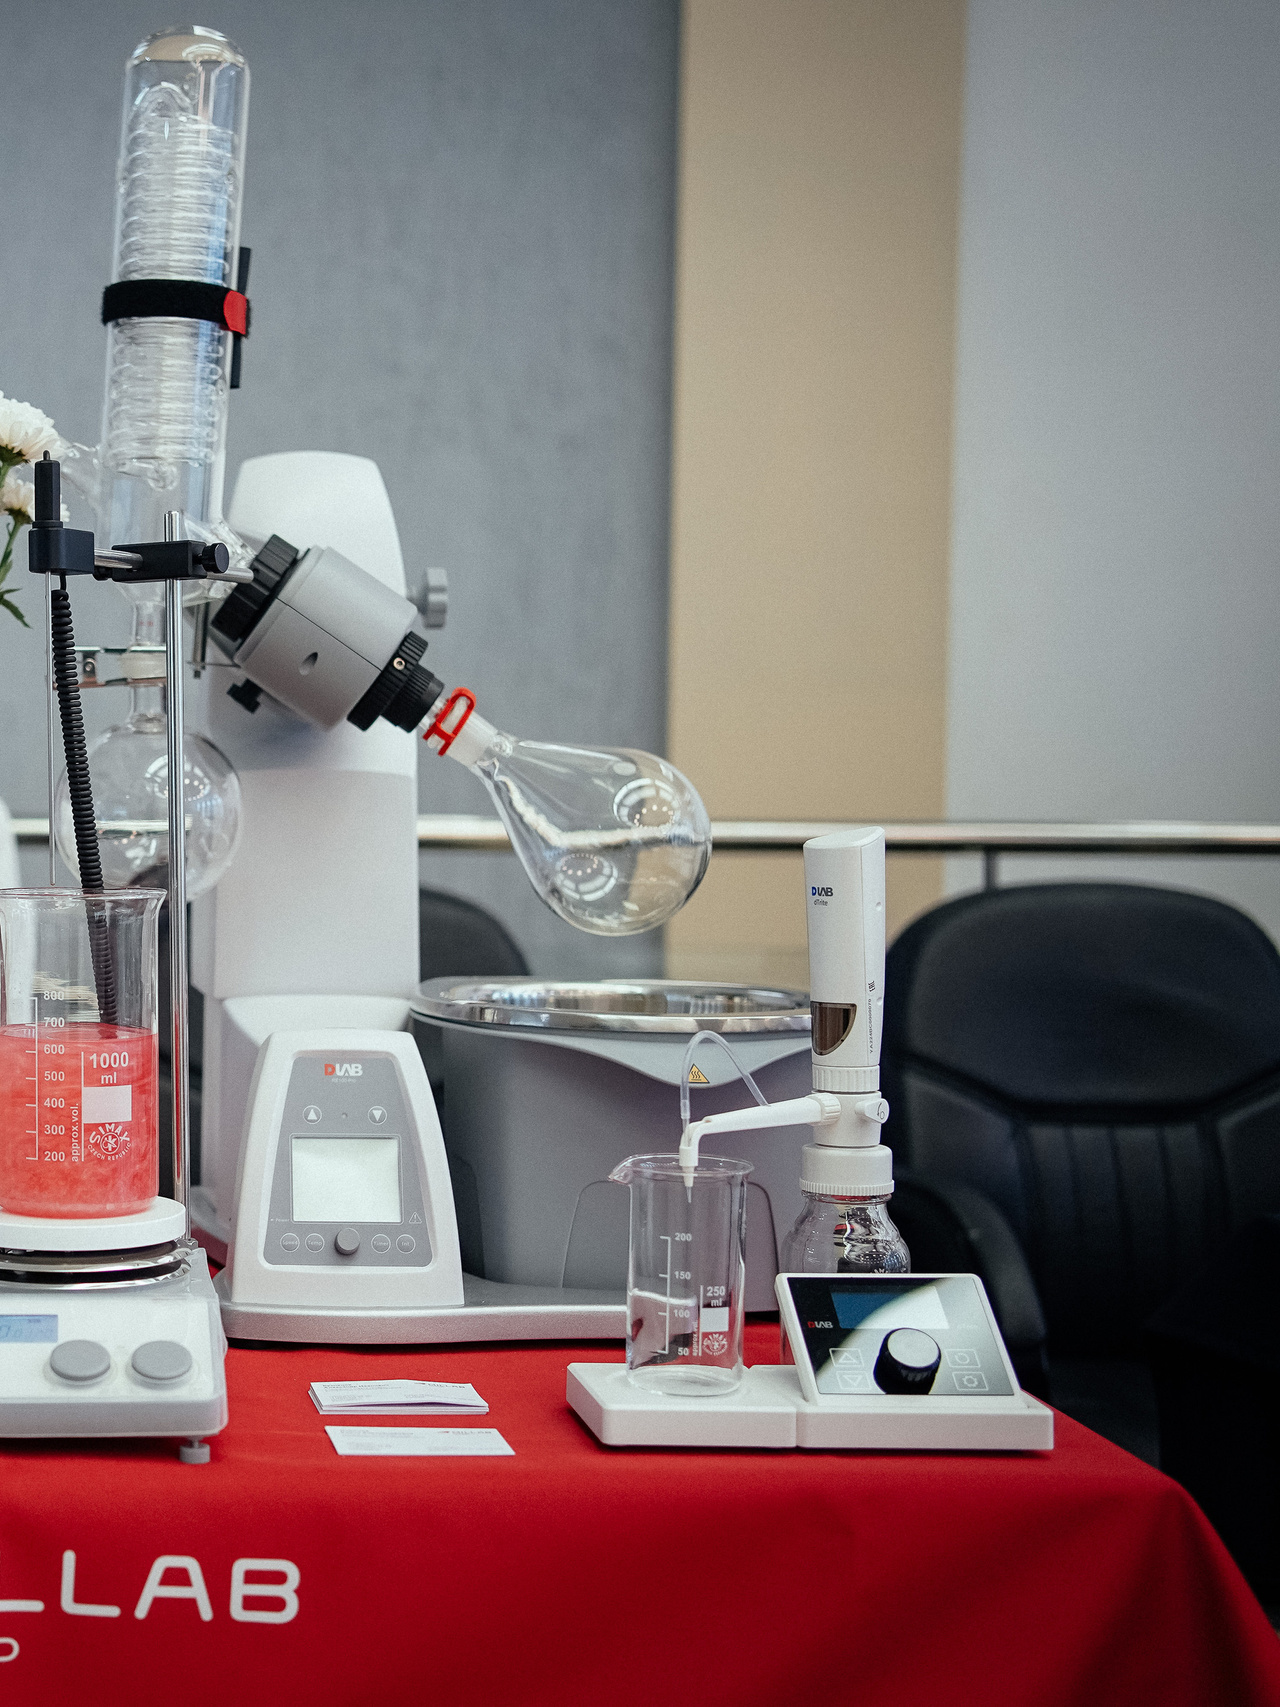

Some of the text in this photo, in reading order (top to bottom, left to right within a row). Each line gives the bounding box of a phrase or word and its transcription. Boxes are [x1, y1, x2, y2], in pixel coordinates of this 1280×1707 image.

[811, 886, 834, 897] DLAB
[43, 991, 65, 1000] 800
[43, 1017, 65, 1027] 700
[43, 1044, 65, 1054] 600
[89, 1052, 129, 1068] 1000
[324, 1063, 363, 1077] DLAB
[43, 1071, 65, 1081] 500
[101, 1072, 117, 1084] ml
[43, 1098, 65, 1108] 400
[43, 1125, 65, 1135] 300
[71, 1103, 79, 1162] approx.vol.
[89, 1123, 130, 1144] SIMAX
[43, 1151, 65, 1162] 200
[87, 1142, 132, 1161] CZECH REPUBLIC
[674, 1232, 692, 1242] 200
[674, 1271, 691, 1280] 150
[706, 1286, 726, 1296] 250
[711, 1298, 722, 1307] ml
[673, 1309, 690, 1318] 100
[807, 1321, 834, 1329] DLAB
[677, 1347, 690, 1356] 50
